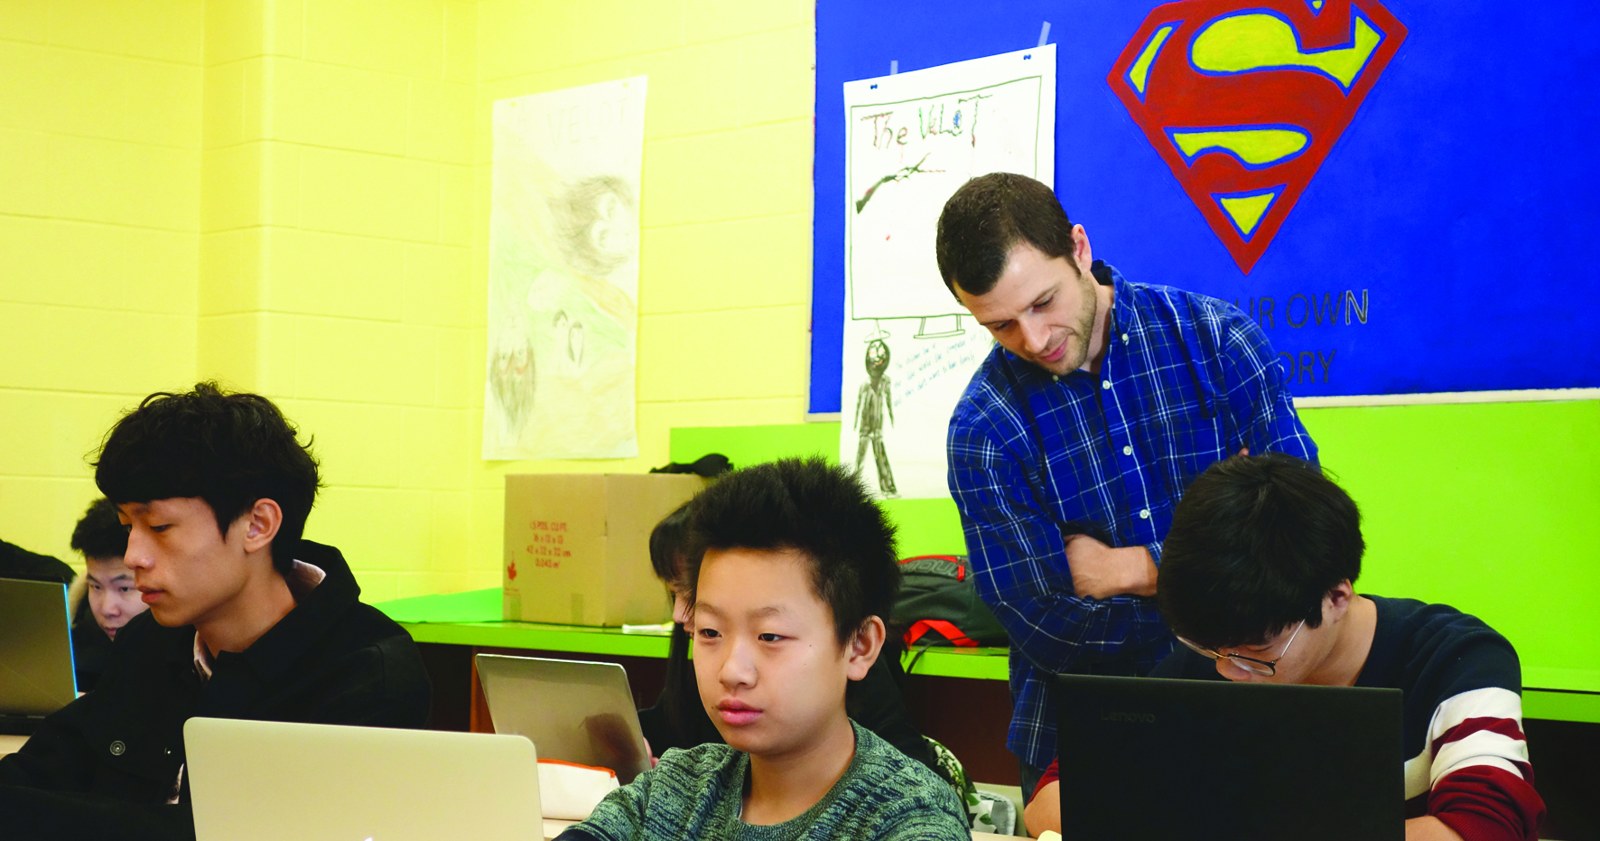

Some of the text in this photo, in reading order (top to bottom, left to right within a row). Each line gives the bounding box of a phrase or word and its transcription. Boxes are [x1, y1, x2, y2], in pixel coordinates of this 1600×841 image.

[860, 111, 908, 150] The
[1285, 289, 1369, 329] OWN
[1100, 707, 1156, 723] Lenovo
